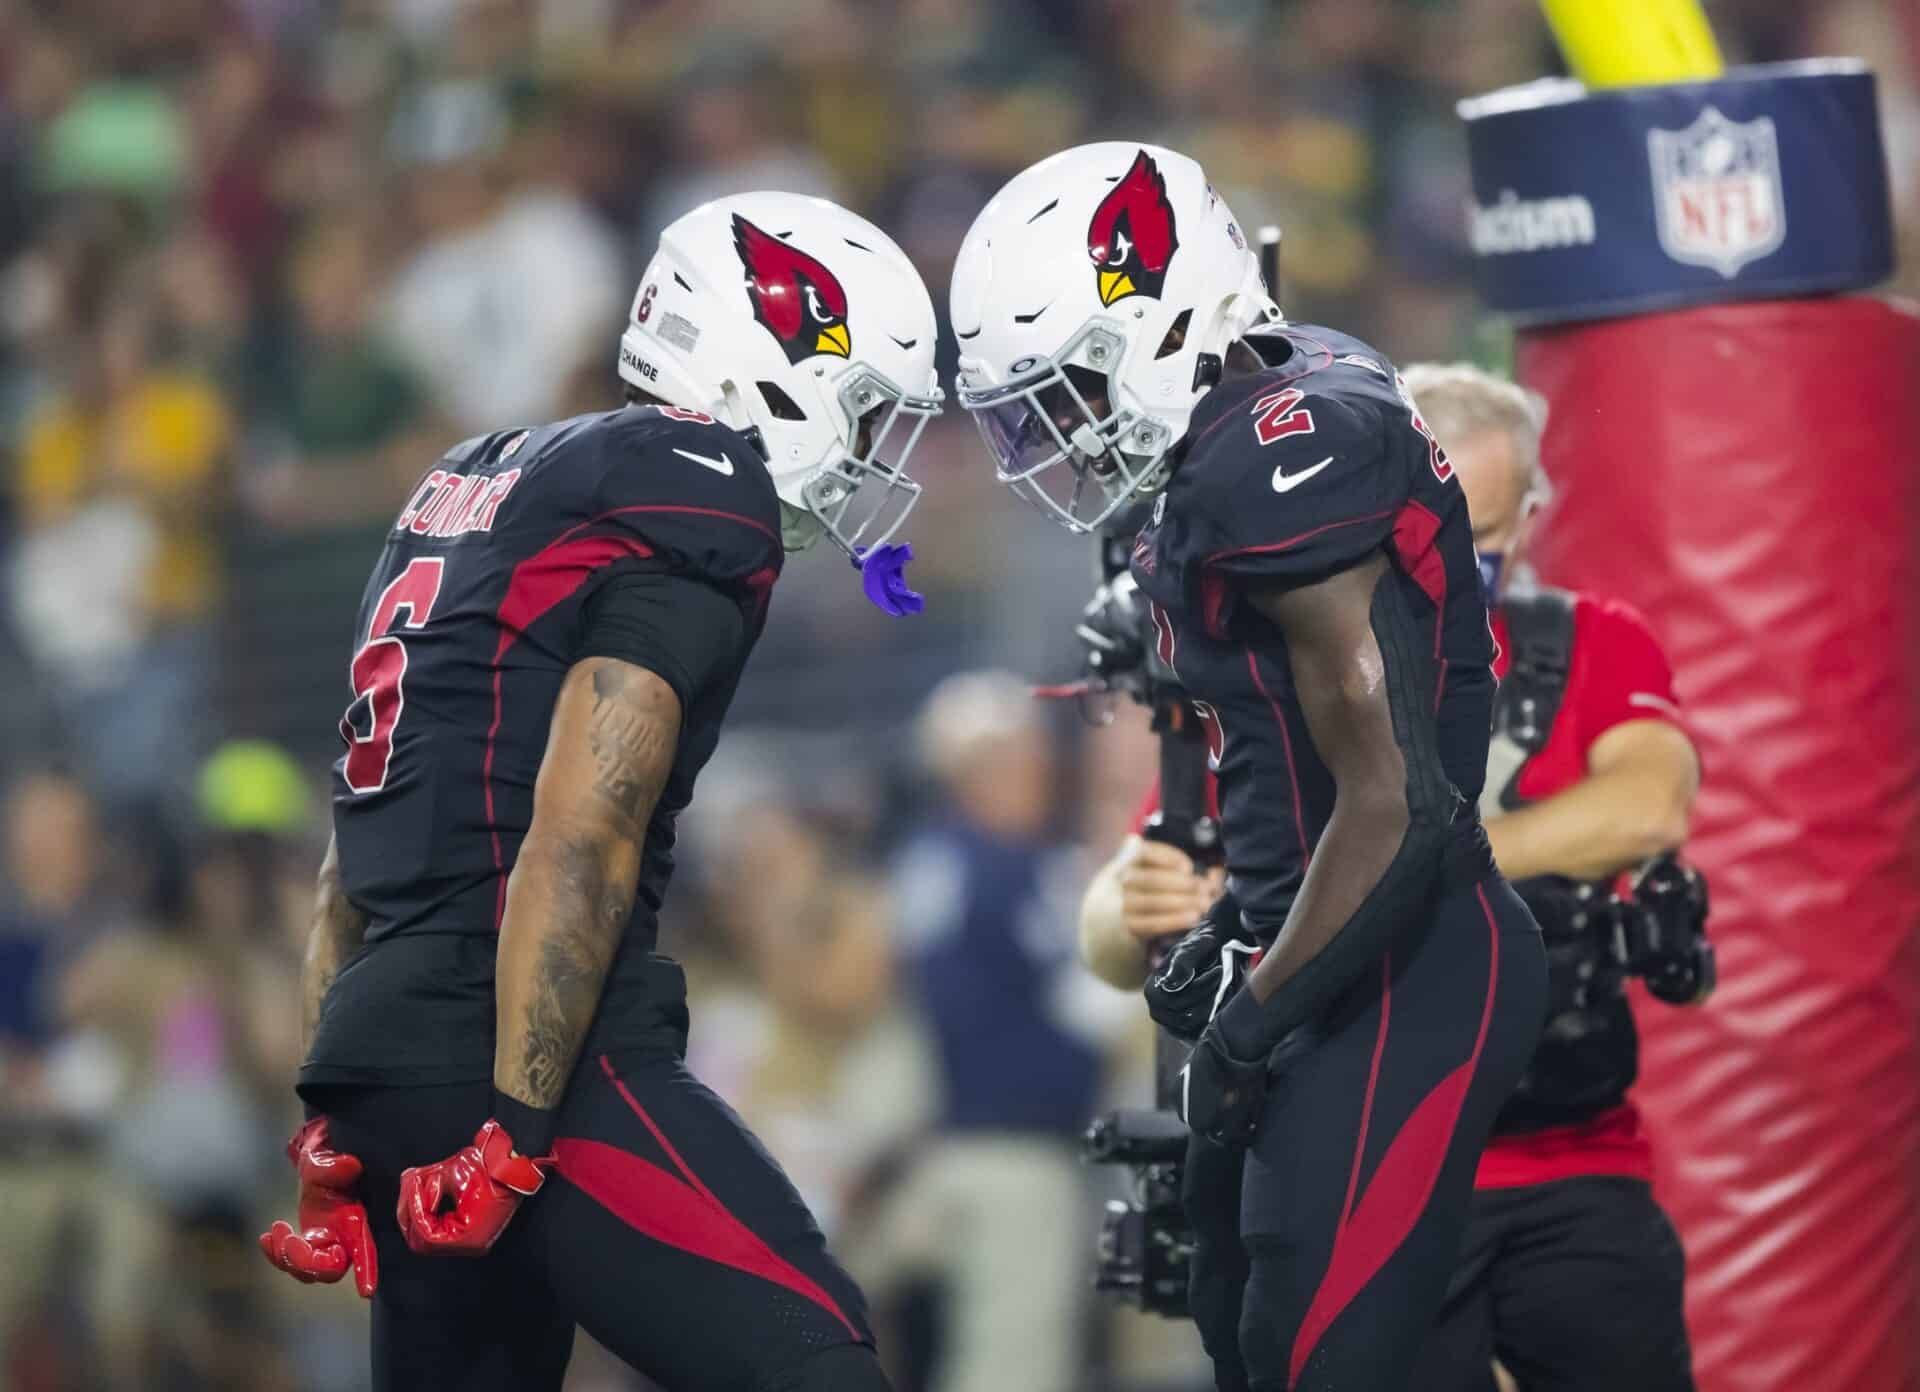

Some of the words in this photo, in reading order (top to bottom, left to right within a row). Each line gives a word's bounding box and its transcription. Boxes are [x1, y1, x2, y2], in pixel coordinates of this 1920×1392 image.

[1668, 177, 1777, 246] NFL
[637, 283, 658, 323] 6
[622, 347, 658, 382] CHANGE
[1251, 387, 1316, 446] 2
[338, 556, 446, 794] 6
